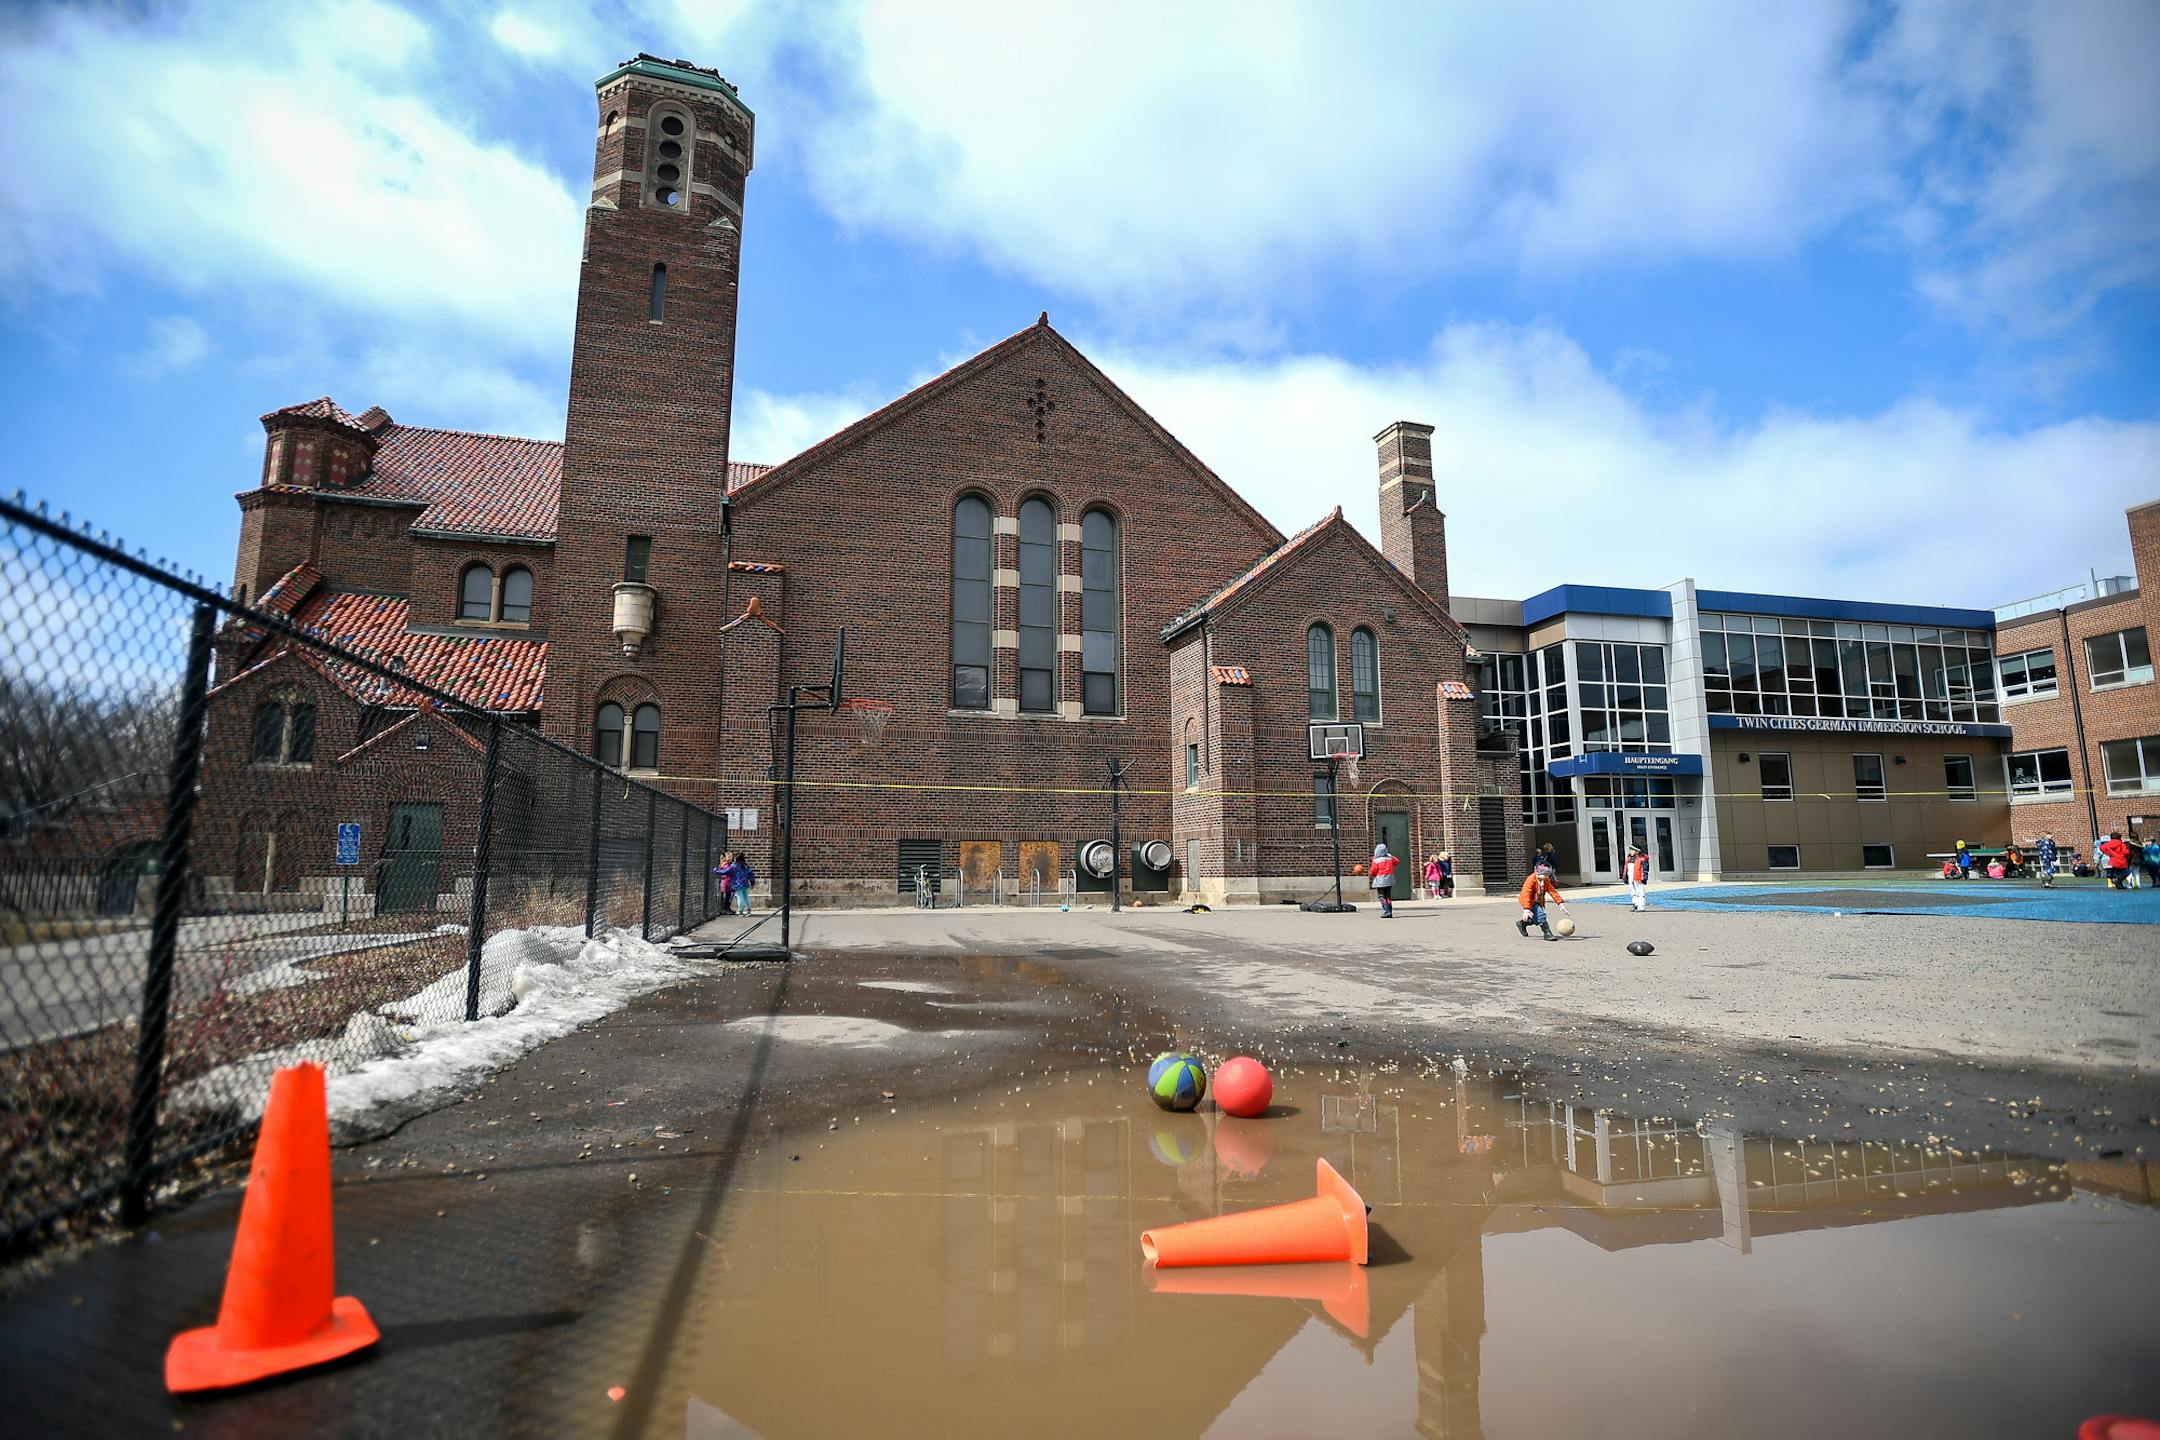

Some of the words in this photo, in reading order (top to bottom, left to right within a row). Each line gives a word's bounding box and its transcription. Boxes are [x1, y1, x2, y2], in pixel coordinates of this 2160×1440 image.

[1736, 717, 1768, 728] TWIN
[1769, 718, 1806, 730] CITIES
[1807, 720, 1856, 731] GERMAN
[1858, 721, 1920, 733] IMMERSION
[1922, 723, 1967, 735] SCHOOL
[1624, 756, 1679, 765] HAUPTEINGANG
